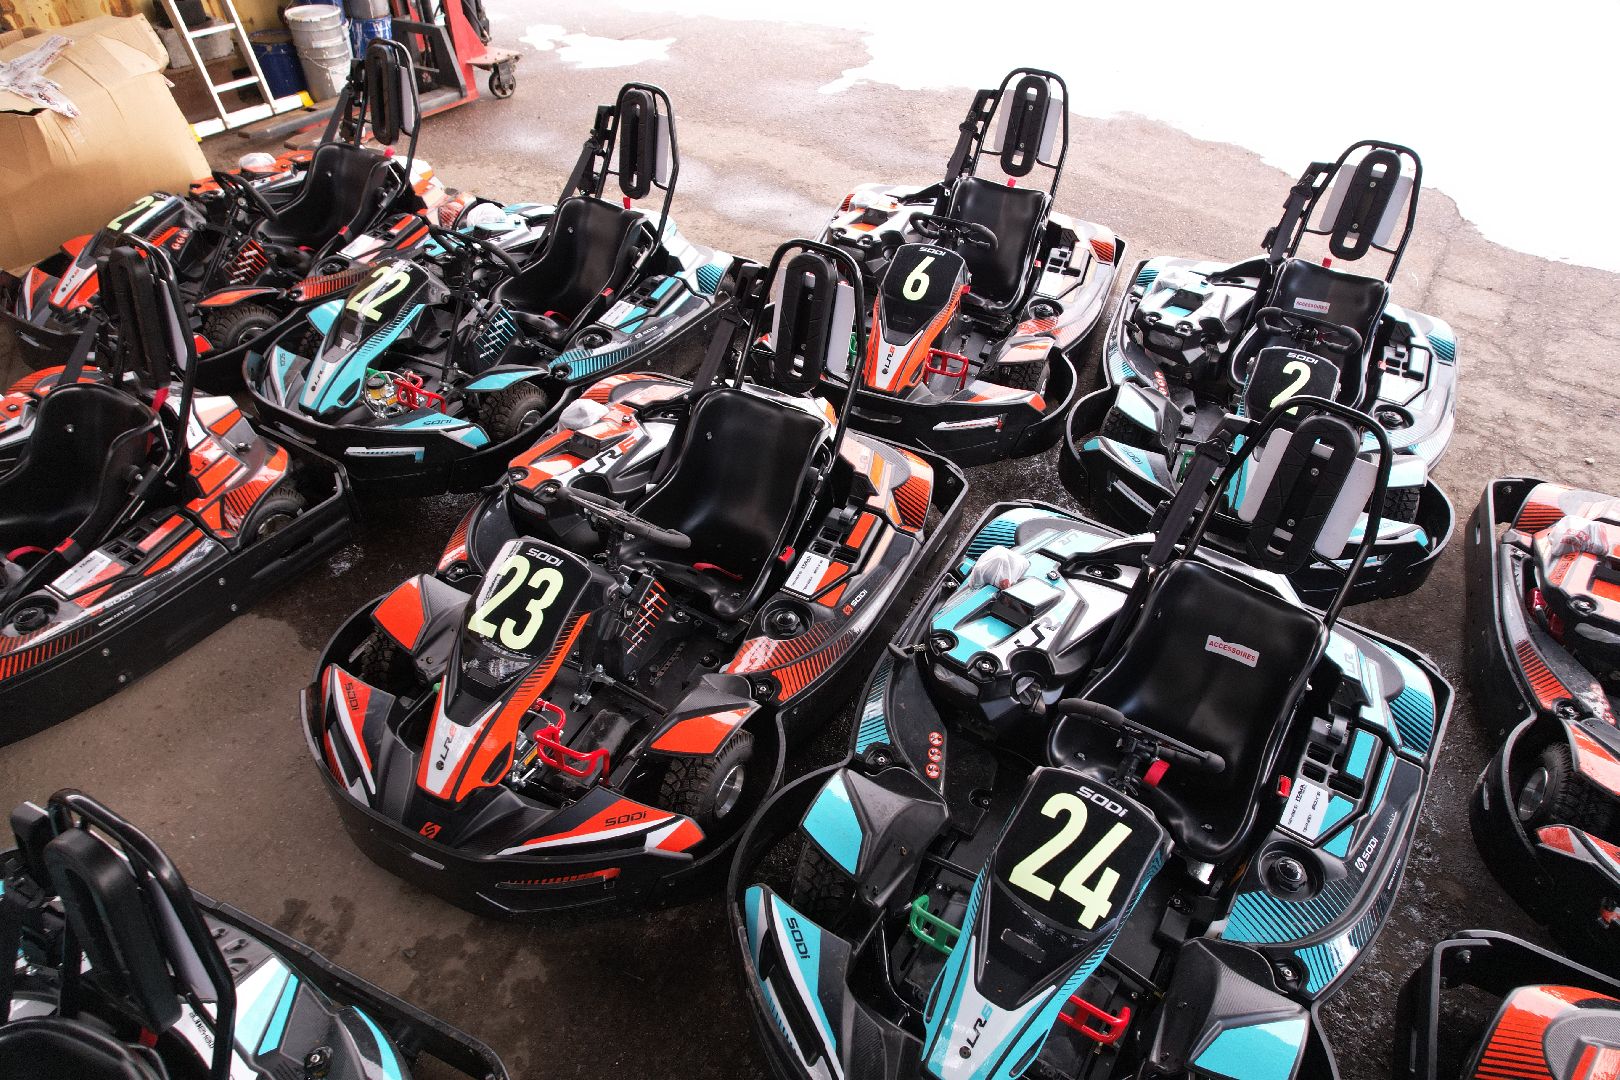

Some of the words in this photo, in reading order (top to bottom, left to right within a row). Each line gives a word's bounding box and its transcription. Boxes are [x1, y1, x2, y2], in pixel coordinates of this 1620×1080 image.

[107, 195, 168, 233] 21
[346, 266, 410, 321] 22
[903, 256, 936, 301] 6
[1269, 360, 1311, 415] 2
[467, 554, 564, 650] 23
[1208, 640, 1256, 662] ACCESSOIRES
[1008, 792, 1133, 930] 24
